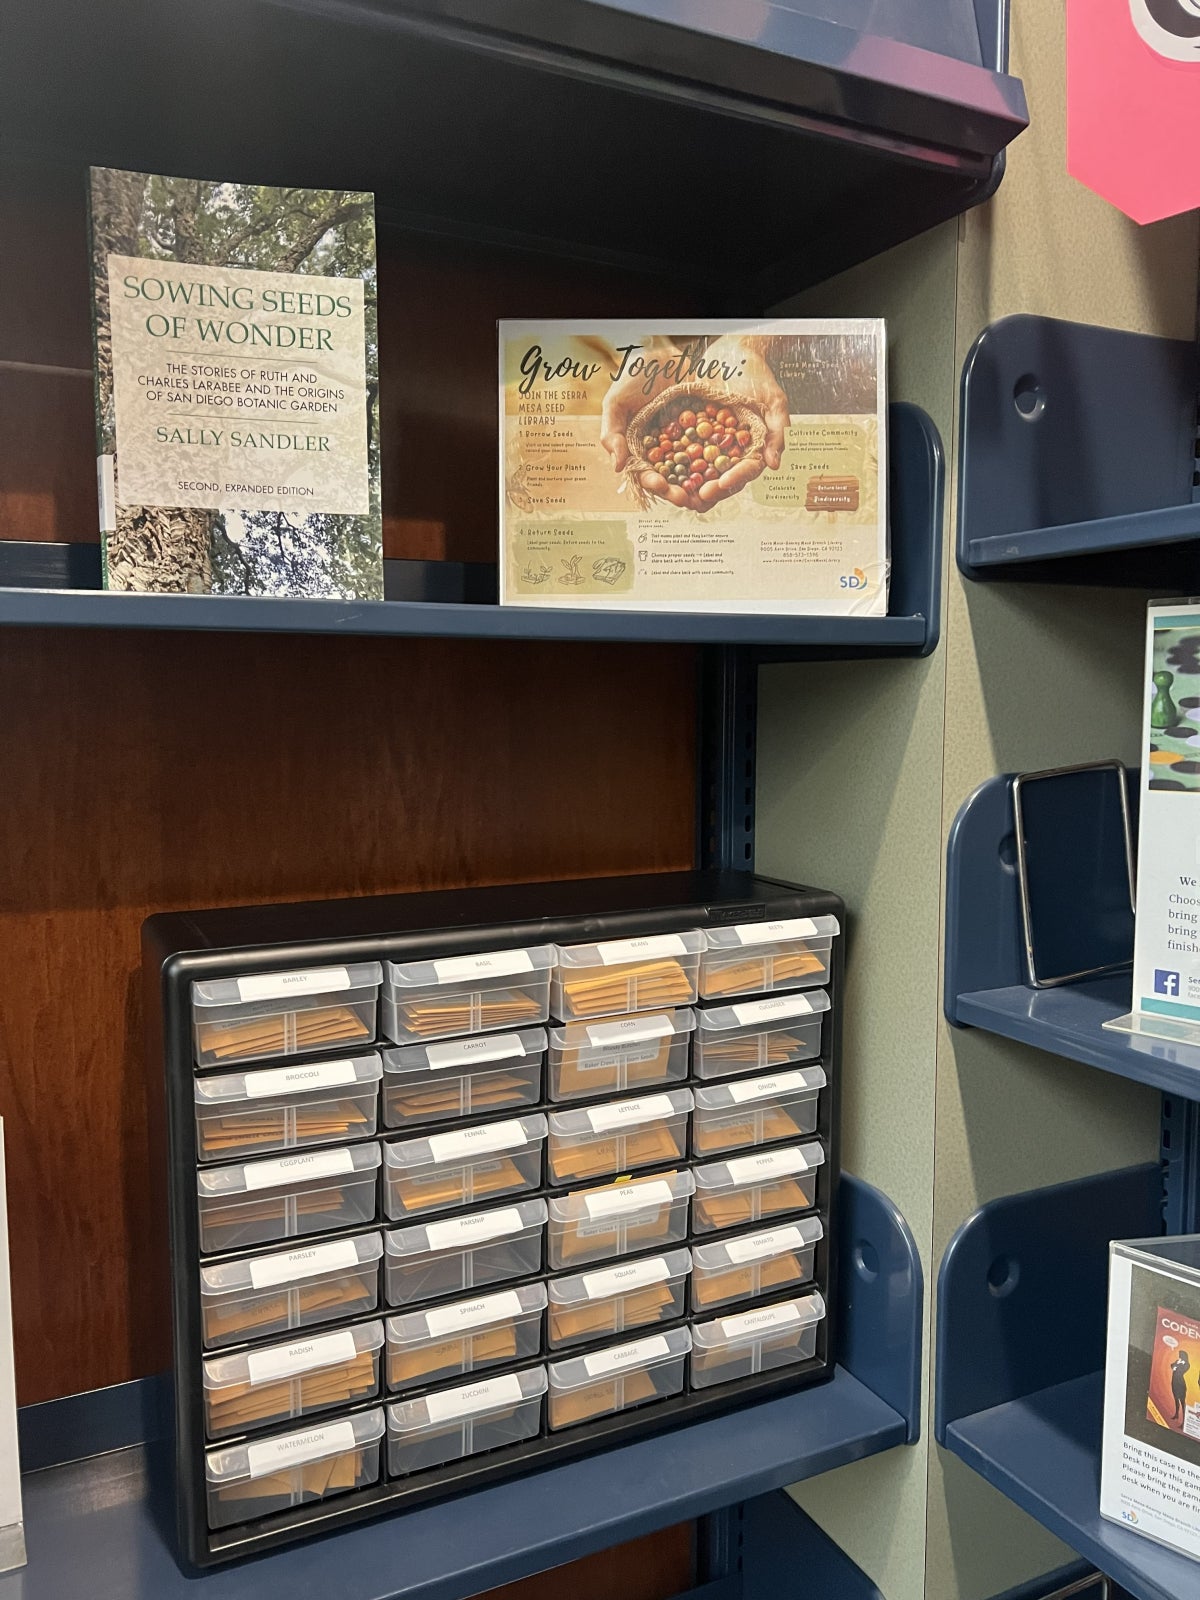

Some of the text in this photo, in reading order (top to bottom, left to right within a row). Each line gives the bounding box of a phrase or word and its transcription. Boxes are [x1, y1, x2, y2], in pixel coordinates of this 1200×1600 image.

[123, 276, 351, 318] SOWING SEEDS
[146, 314, 334, 350] OF WONDER
[166, 363, 317, 384] THE STORIES OF RUTH AND
[519, 345, 746, 395] Grow Together:
[138, 375, 344, 400] CHARLES LARABEE AND THE ORIGINS
[519, 390, 587, 400] JOIN THE SERRA
[146, 390, 337, 413] OF SAN DIEGO BOTANIC GARDEN
[519, 403, 565, 413] MESA SEED
[519, 416, 556, 425] LIBRARY
[156, 426, 330, 452] SALLY SANDLER
[178, 481, 314, 496] SECOND, EXPANDED EDITION
[840, 576, 860, 588] SD
[1180, 876, 1197, 886] We
[1169, 909, 1198, 923] bring
[1168, 924, 1197, 939] bring
[1168, 940, 1200, 953] finish
[464, 1042, 486, 1050] CARROT
[286, 1071, 320, 1080] BROCCOLI
[618, 1104, 641, 1113] LETTUCE
[464, 1130, 487, 1138] FENNEL
[280, 1156, 314, 1167] EGGPLANT
[756, 1157, 774, 1165] PEPPER
[460, 1217, 484, 1227] PARSNIP
[752, 1236, 774, 1247] TOMATO
[289, 1251, 316, 1261] PARSLEY
[614, 1269, 636, 1279] SQUASH
[460, 1304, 485, 1315] SPINACH
[744, 1314, 776, 1325] CANTALOUPE
[289, 1346, 314, 1356] RADISH
[462, 1387, 489, 1399] ZUCCHINI
[276, 1433, 325, 1451] WATERMELON
[1123, 1442, 1200, 1480] Bring this case to the
[1123, 1453, 1141, 1465] Desk
[1142, 1461, 1150, 1469] to
[1152, 1466, 1167, 1478] play
[1170, 1473, 1183, 1484] this
[1122, 1463, 1145, 1478] Please
[1147, 1474, 1166, 1489] bring
[1168, 1484, 1180, 1494] the
[1122, 1474, 1138, 1486] desk
[1140, 1482, 1160, 1496] when
[1163, 1492, 1176, 1503] you
[1178, 1500, 1190, 1509] are
